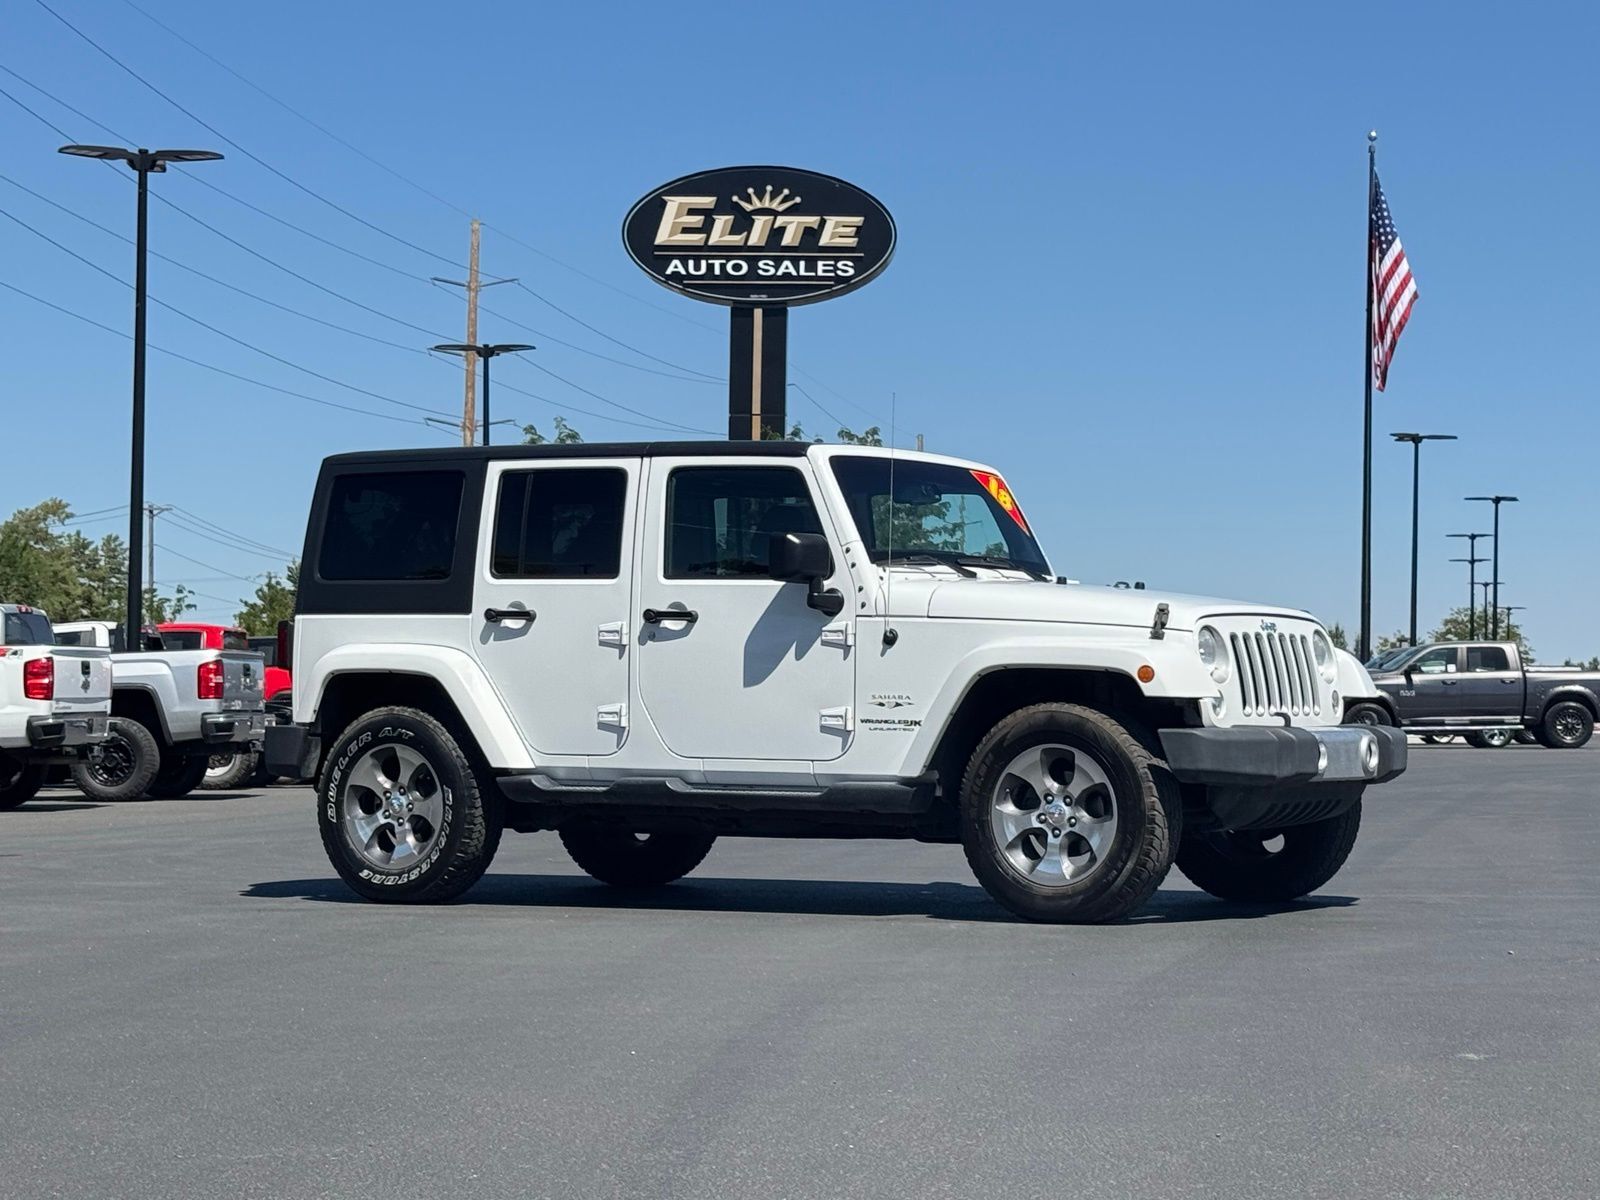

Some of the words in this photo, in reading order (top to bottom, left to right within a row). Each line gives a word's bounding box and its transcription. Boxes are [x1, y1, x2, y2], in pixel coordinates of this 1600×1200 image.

[654, 196, 865, 247] ELITE
[665, 259, 749, 276] AUTO
[757, 260, 855, 277] SALES
[328, 732, 372, 823] DUELER
